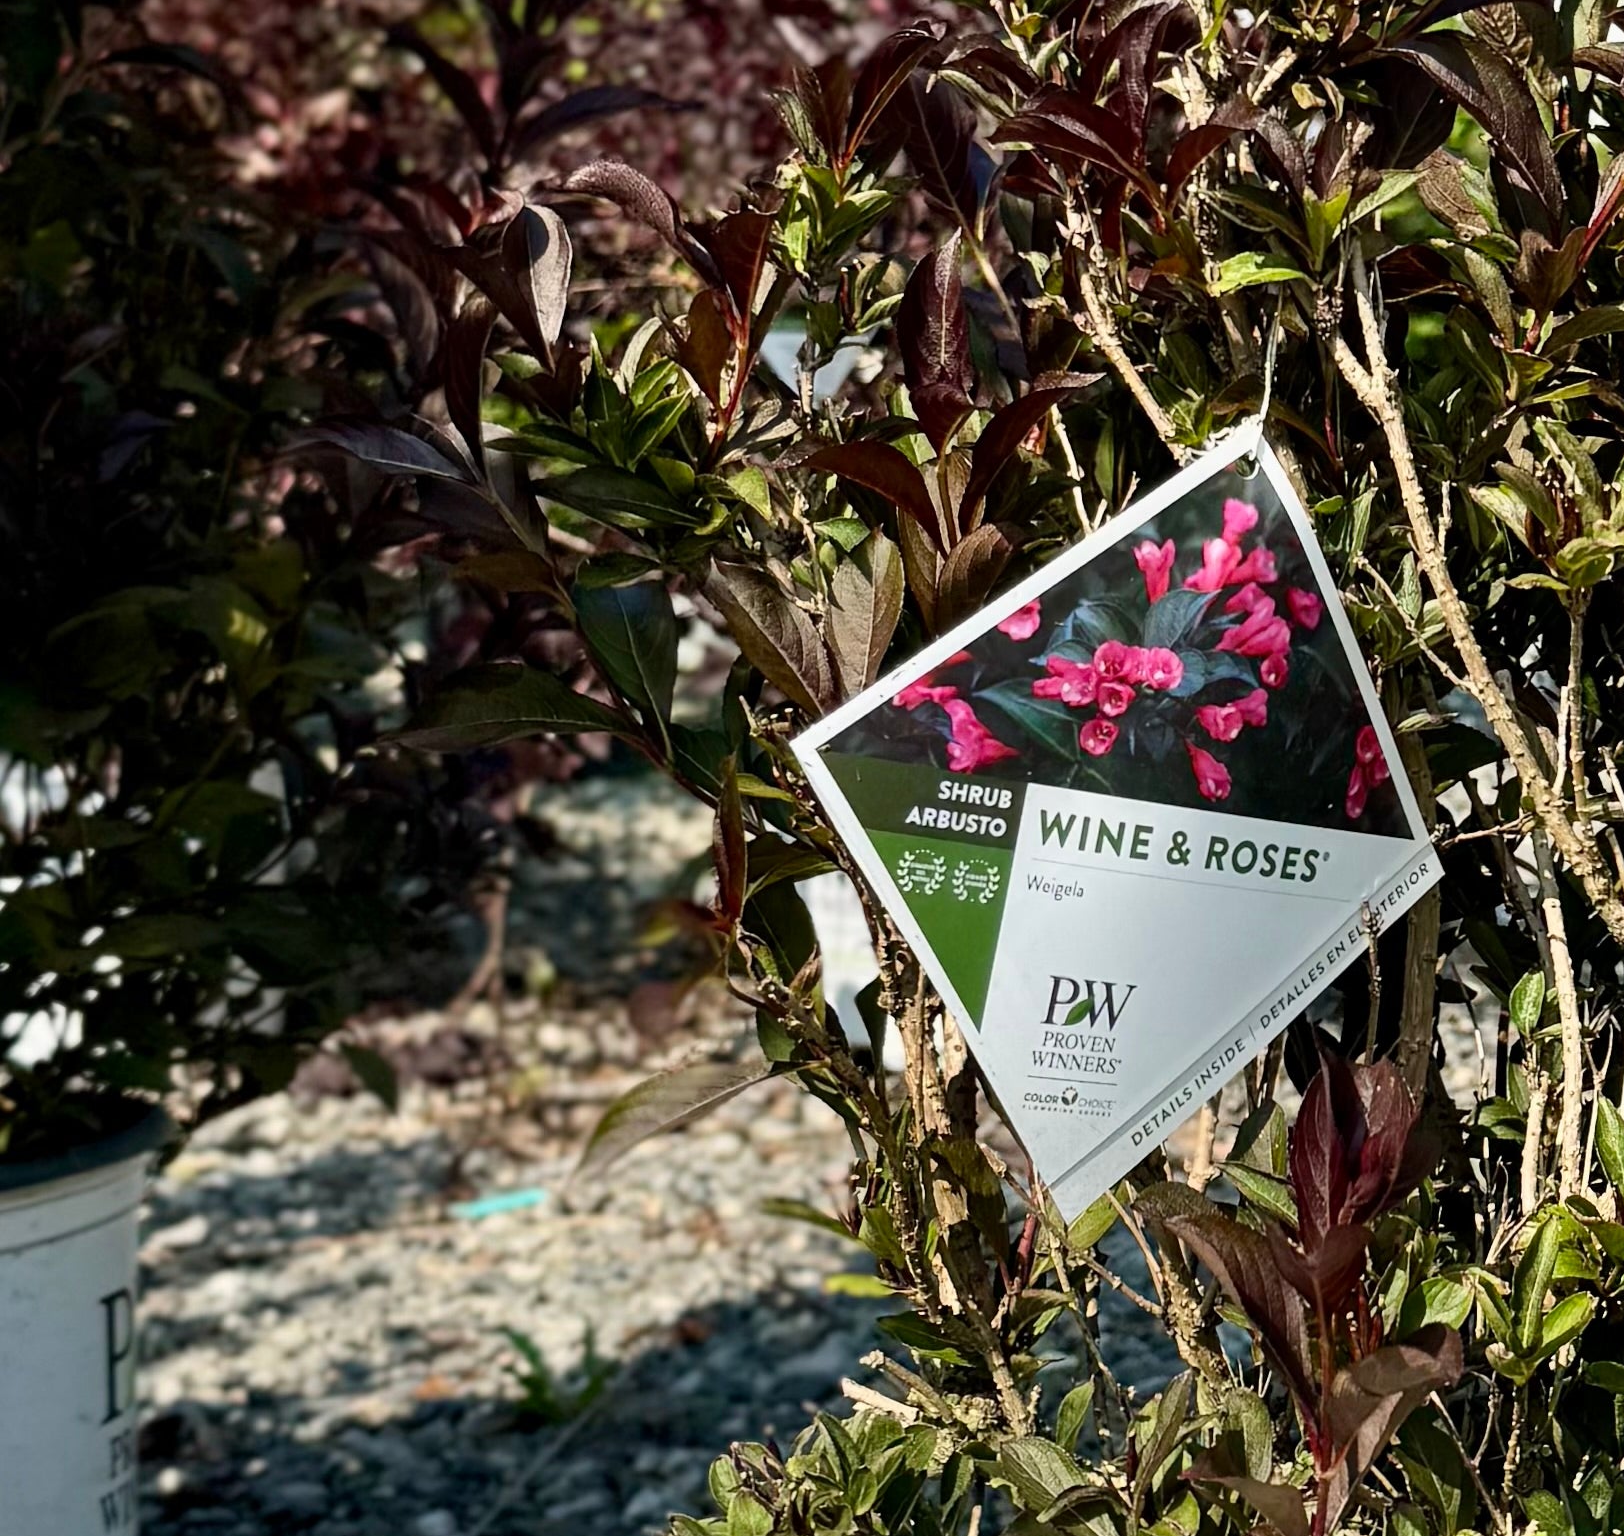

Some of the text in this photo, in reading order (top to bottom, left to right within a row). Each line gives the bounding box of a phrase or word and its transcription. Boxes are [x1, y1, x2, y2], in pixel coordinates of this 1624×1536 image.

[938, 780, 1013, 809] SHRUB
[905, 805, 1008, 838] ARBUSTO
[1040, 809, 1154, 861] WINE
[1166, 830, 1192, 866] &
[1027, 874, 1085, 901] Weigela
[1040, 975, 1138, 1032] PW
[1041, 1031, 1117, 1053] PROVEN
[1131, 1087, 1193, 1146] DETAILS
[1194, 1038, 1246, 1090] INSIDE
[1260, 961, 1326, 1030] DETALLES
[1326, 940, 1346, 965] EN
[1348, 925, 1366, 944] EL
[1023, 1092, 1060, 1104] COLOR
